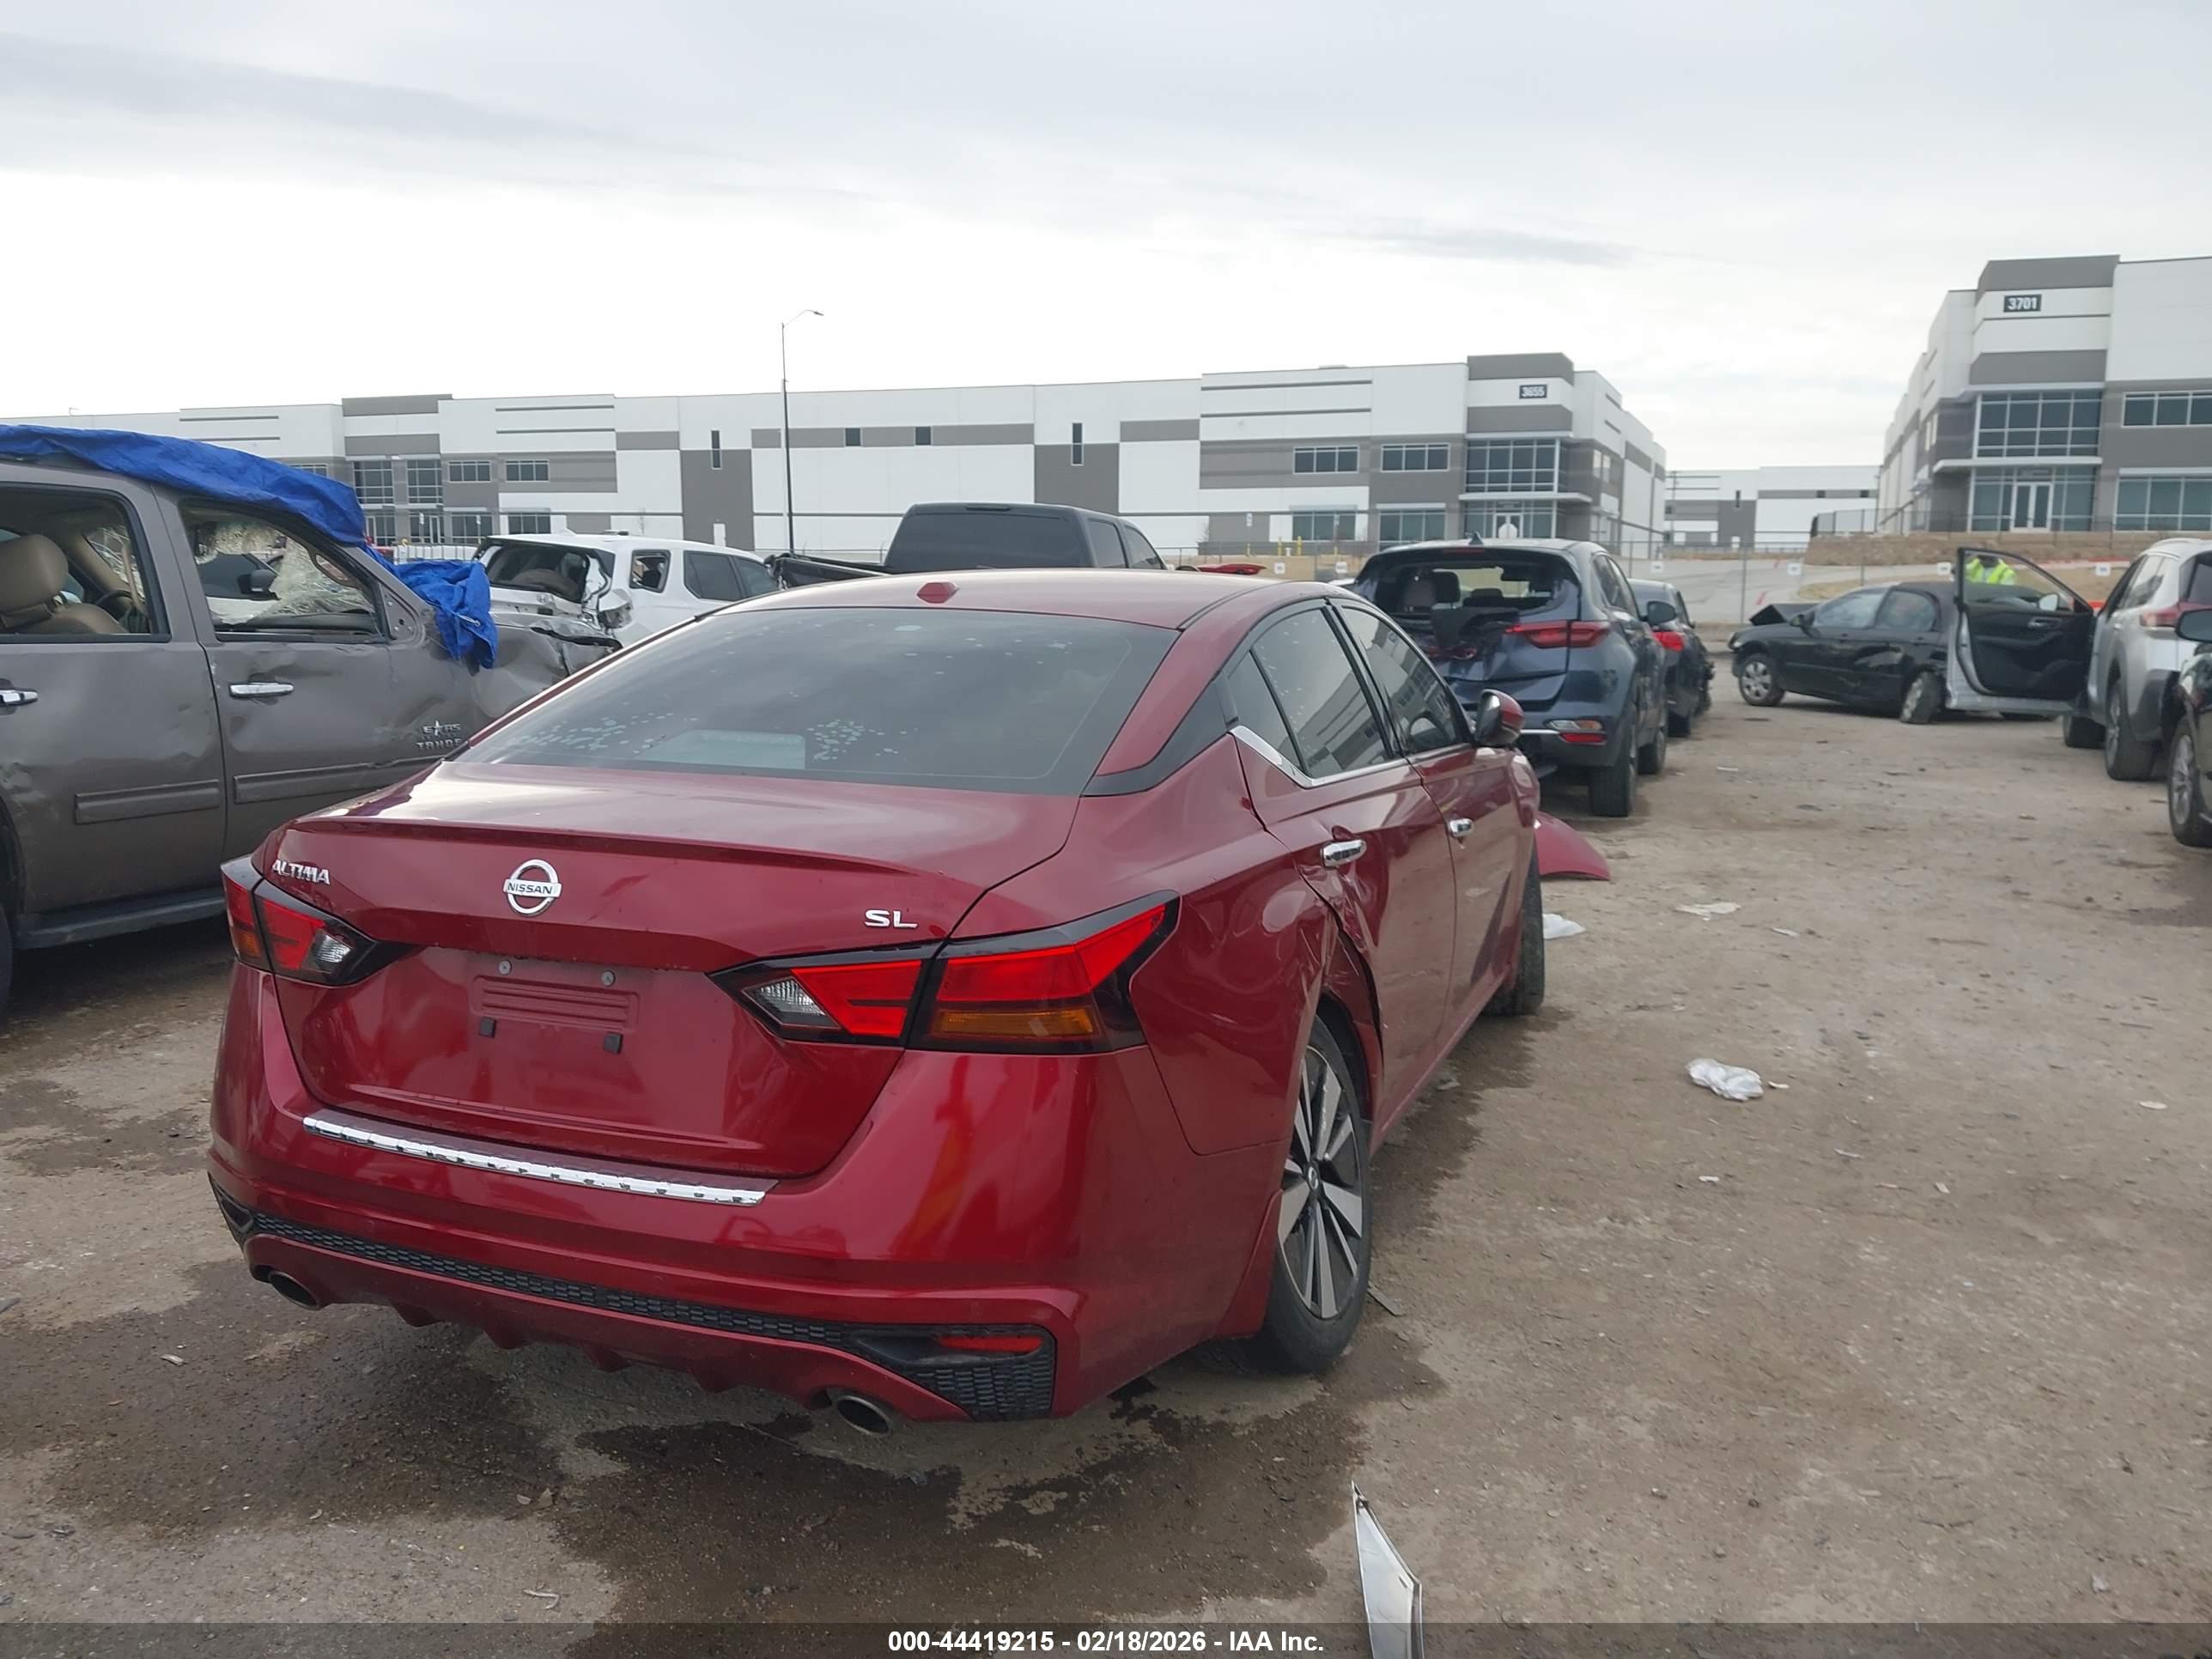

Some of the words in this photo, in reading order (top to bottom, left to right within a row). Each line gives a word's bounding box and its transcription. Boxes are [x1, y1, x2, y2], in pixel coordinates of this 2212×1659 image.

[2008, 297, 2037, 310] 3701
[271, 859, 331, 885] ALTIMA
[507, 882, 553, 895] NISSAN
[864, 909, 918, 928] SL
